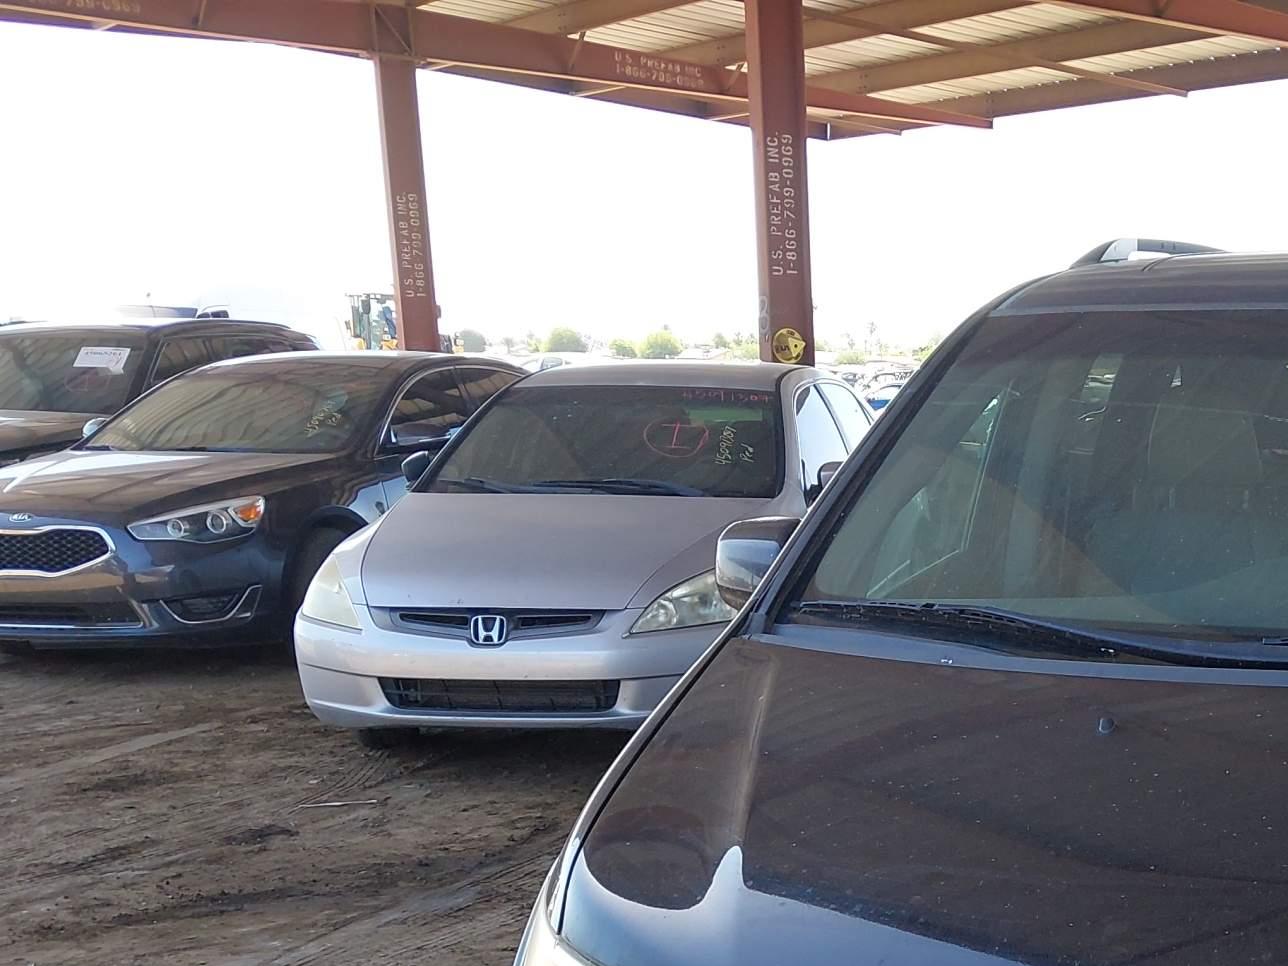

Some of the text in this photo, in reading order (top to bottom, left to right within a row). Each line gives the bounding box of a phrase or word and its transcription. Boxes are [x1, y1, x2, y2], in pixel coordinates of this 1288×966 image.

[398, 222, 412, 269] PREFAB
[767, 131, 784, 276] U.S. PREFAB INC.
[781, 134, 798, 274] 1-866-799-0969
